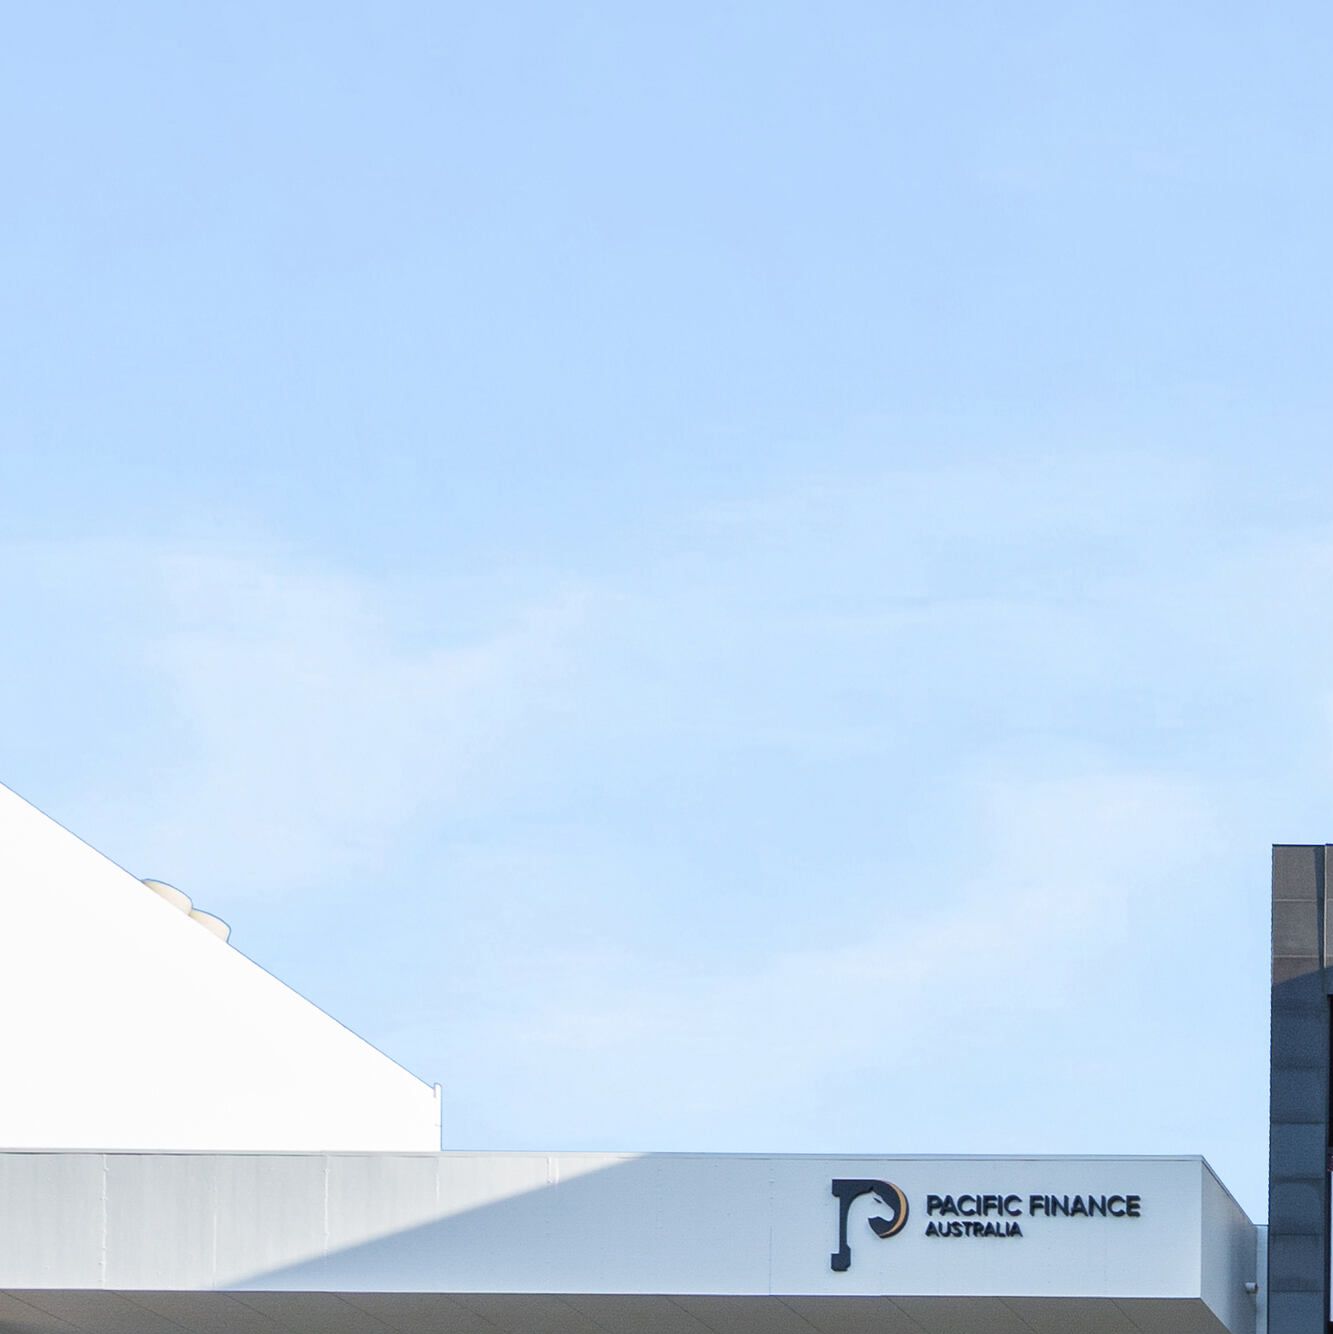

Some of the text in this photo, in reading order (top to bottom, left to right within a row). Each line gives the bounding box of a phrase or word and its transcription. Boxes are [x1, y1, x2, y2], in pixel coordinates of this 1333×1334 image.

[926, 1195, 1141, 1217] PACIFIC FINANCE
[925, 1221, 1023, 1237] AUSTRALIA
